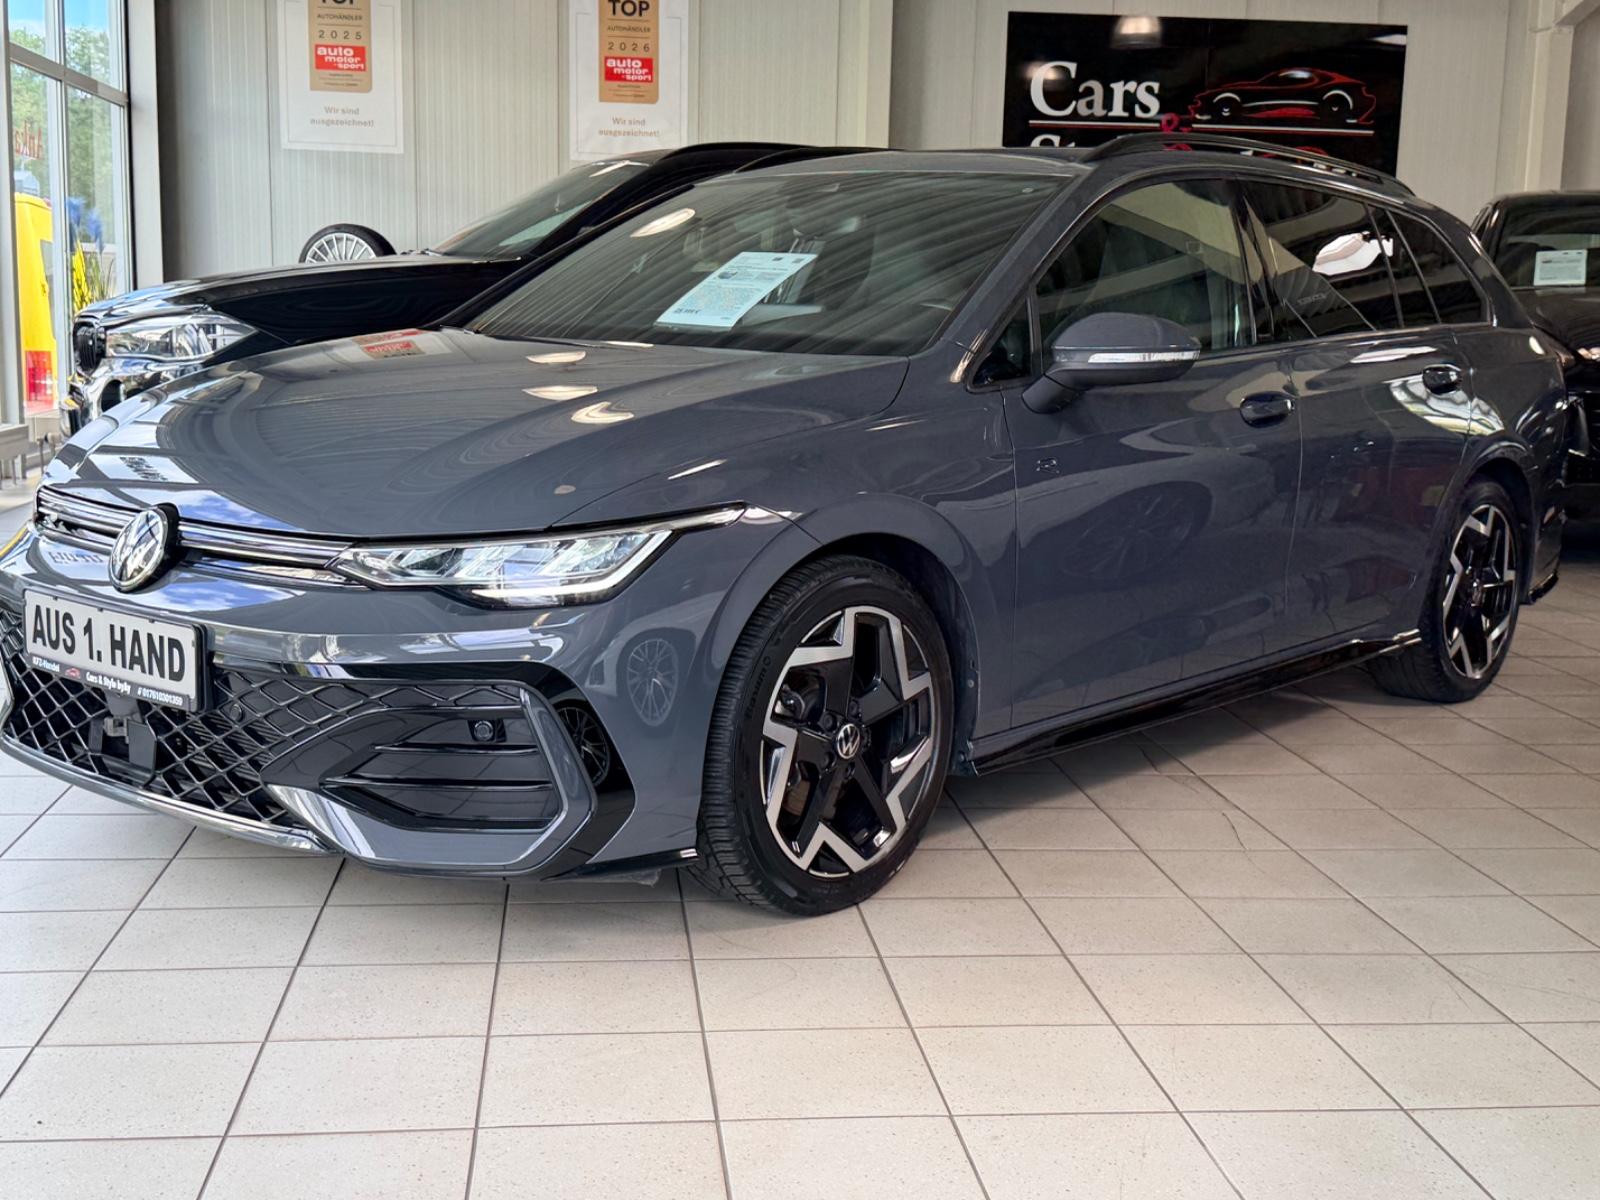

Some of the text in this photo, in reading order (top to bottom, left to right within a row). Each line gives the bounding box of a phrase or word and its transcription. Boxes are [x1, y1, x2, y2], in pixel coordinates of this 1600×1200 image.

[608, 0, 650, 17] TOP
[316, 13, 363, 21] AUTOHÄNDLER
[318, 29, 362, 40] 2025
[607, 25, 651, 33] AUTOHÄNDLER
[316, 46, 354, 57] auto
[607, 41, 651, 52] 2026
[324, 56, 362, 64] motor
[606, 58, 642, 68] auto
[613, 67, 649, 75] motor
[1030, 61, 1161, 119] Cars
[323, 105, 360, 116] Wir sind
[309, 117, 375, 128] ausgezeichnet!
[612, 116, 646, 127] Wir sind
[598, 128, 660, 138] ausgezeichnet!
[32, 604, 186, 683] AUS 1. HAND
[85, 671, 99, 684] Cars
[102, 675, 117, 690] Style
